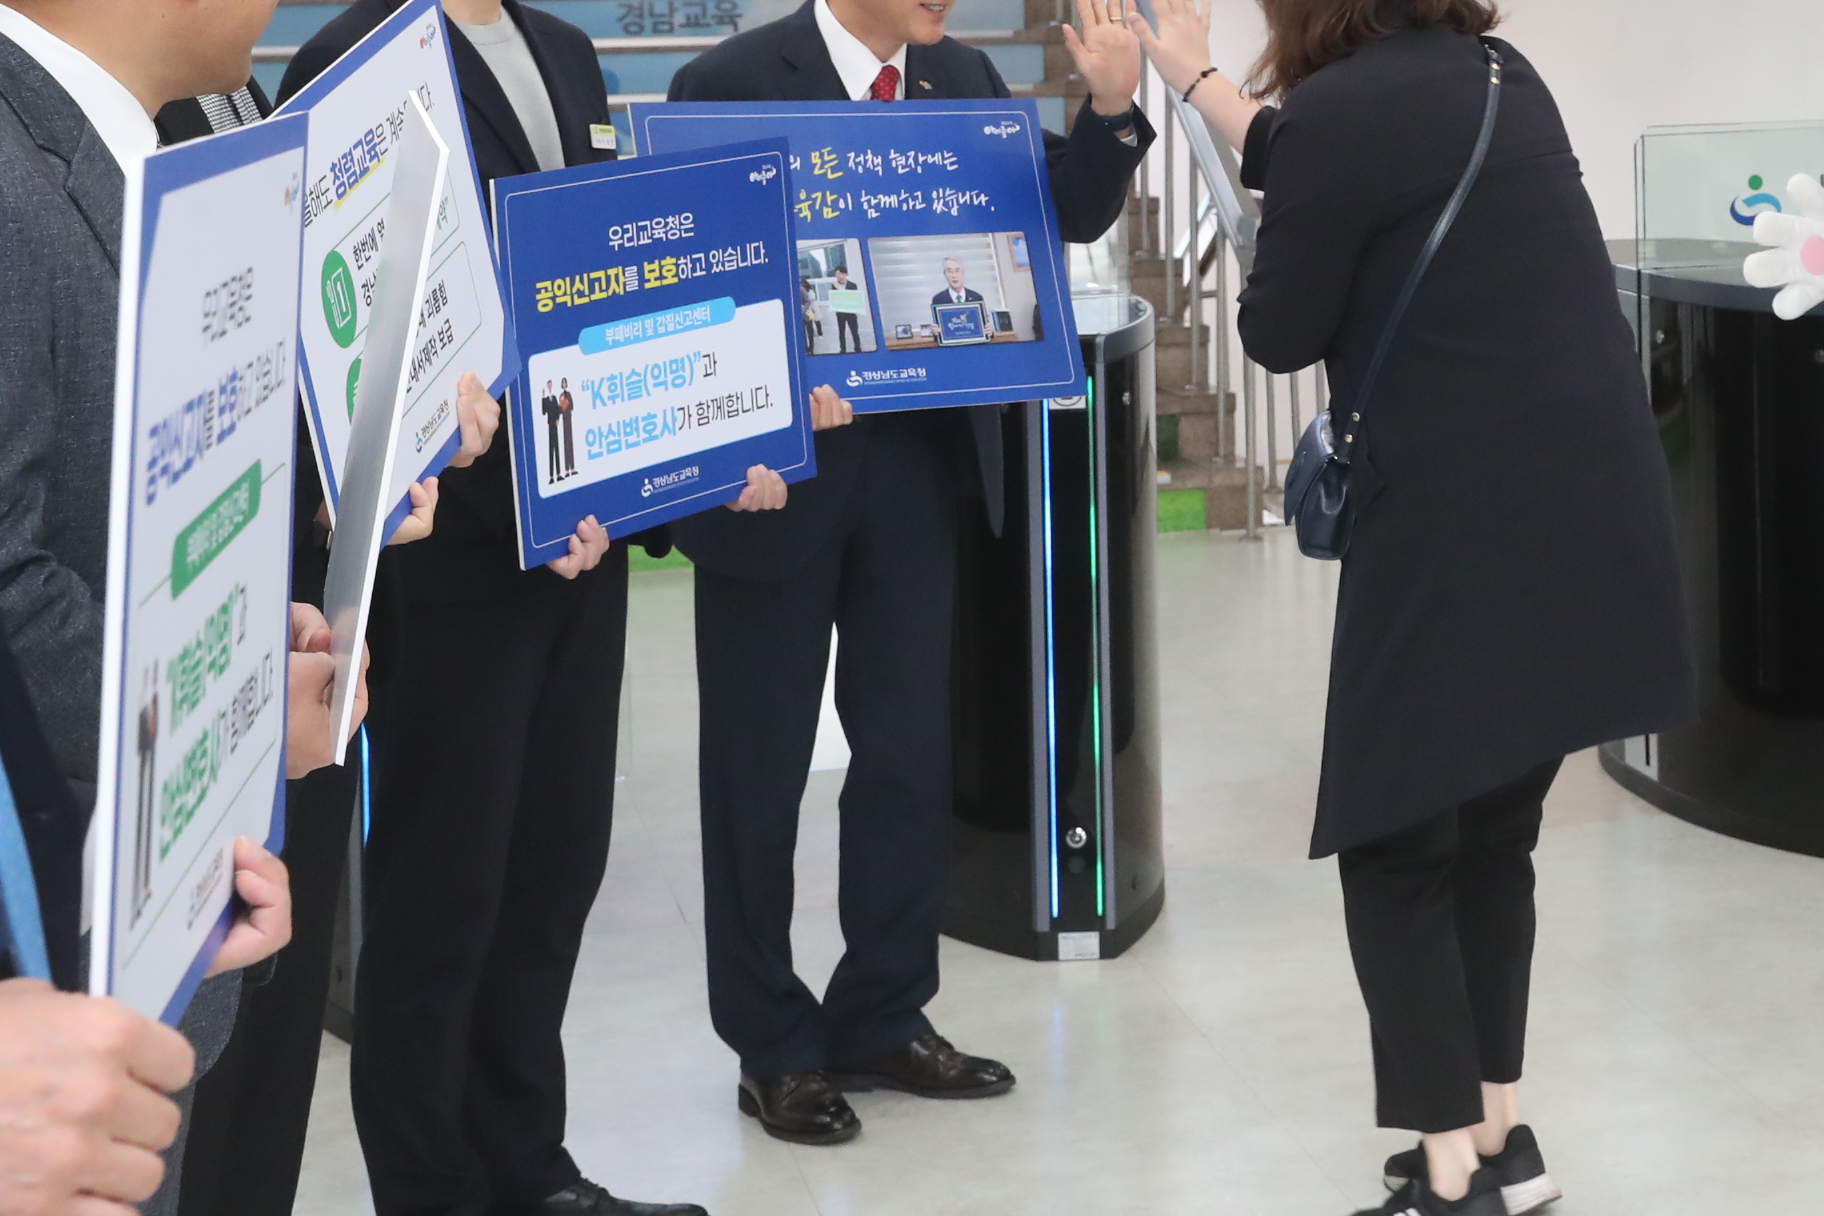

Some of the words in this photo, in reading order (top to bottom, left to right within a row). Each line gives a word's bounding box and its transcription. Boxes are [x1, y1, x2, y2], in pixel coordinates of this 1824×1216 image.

[330, 124, 388, 200] 청렴교육은
[810, 147, 844, 179] 모든
[847, 149, 883, 176] 정책
[889, 148, 959, 175] 현장에는
[793, 188, 852, 222] 육감이
[860, 189, 926, 219] 함께하고
[932, 187, 996, 216] 있습니다.
[353, 226, 379, 271] 한번에
[608, 212, 695, 251] 우리교육청은
[535, 265, 639, 313] 공익신고자를
[643, 252, 707, 290] 보호하고
[709, 240, 769, 274] 있습니다.
[425, 279, 449, 319] 괴롭힘
[437, 318, 454, 351] 보급
[605, 320, 642, 347] 부패비리
[645, 319, 655, 336] 및
[656, 305, 711, 334] 갑질신고센터
[584, 403, 692, 461] 안심변호사가
[695, 384, 774, 428] 함께합니다.
